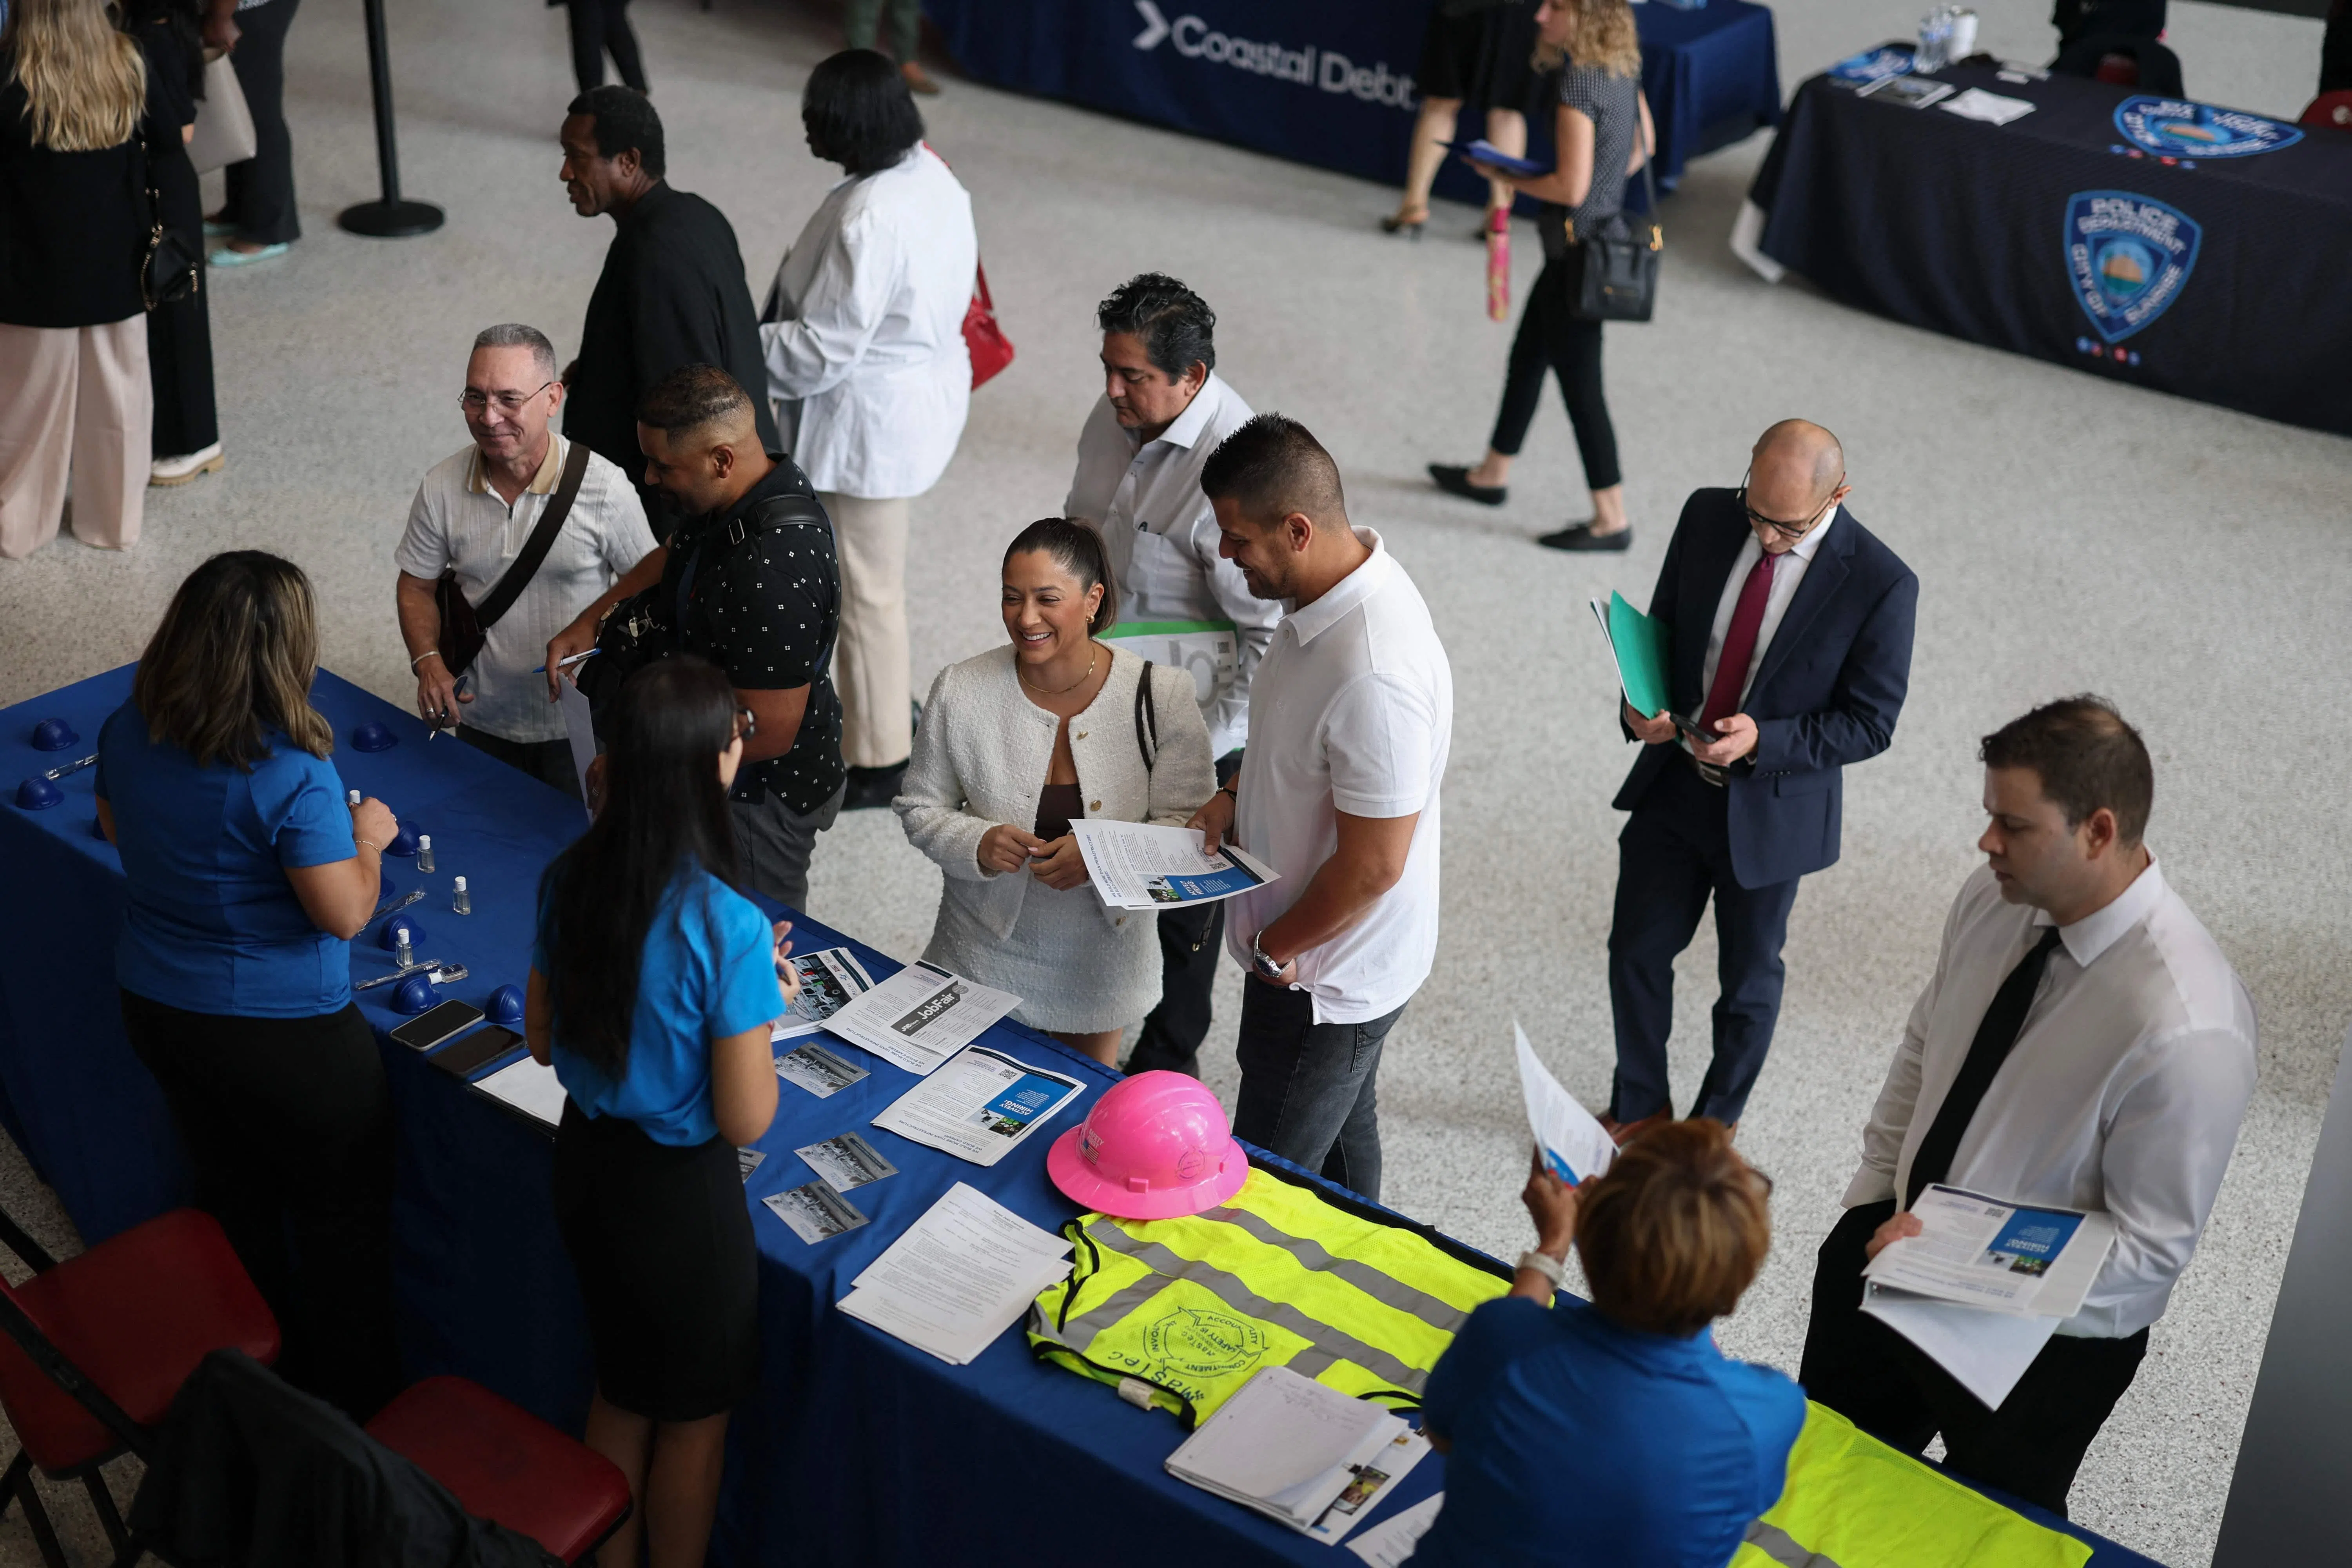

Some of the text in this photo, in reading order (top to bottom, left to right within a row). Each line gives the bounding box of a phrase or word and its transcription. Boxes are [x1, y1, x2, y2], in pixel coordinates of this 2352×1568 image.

[1171, 15, 1318, 85] Coastal
[1086, 835, 1099, 865] INFRASTRUCTURE
[1104, 871, 1113, 884] CAREERS
[1179, 881, 1197, 896] ACTIVELY
[1185, 880, 1205, 895] HIRING:
[917, 993, 955, 1020] JobFair
[844, 1027, 880, 1046] INFRASTRUCTURE
[887, 1045, 907, 1056] CAREERS
[998, 1103, 1030, 1116] ACTIVELY
[1002, 1099, 1034, 1113] HIRING:
[898, 1120, 934, 1136] INFRASTRUCTURE
[942, 1134, 963, 1143] CAREERS
[1087, 1134, 1100, 1147] FIRST
[1088, 1128, 1105, 1145] SAFETY
[1207, 1331, 1237, 1352] SAFETY
[1108, 1351, 1194, 1401] MasTec
